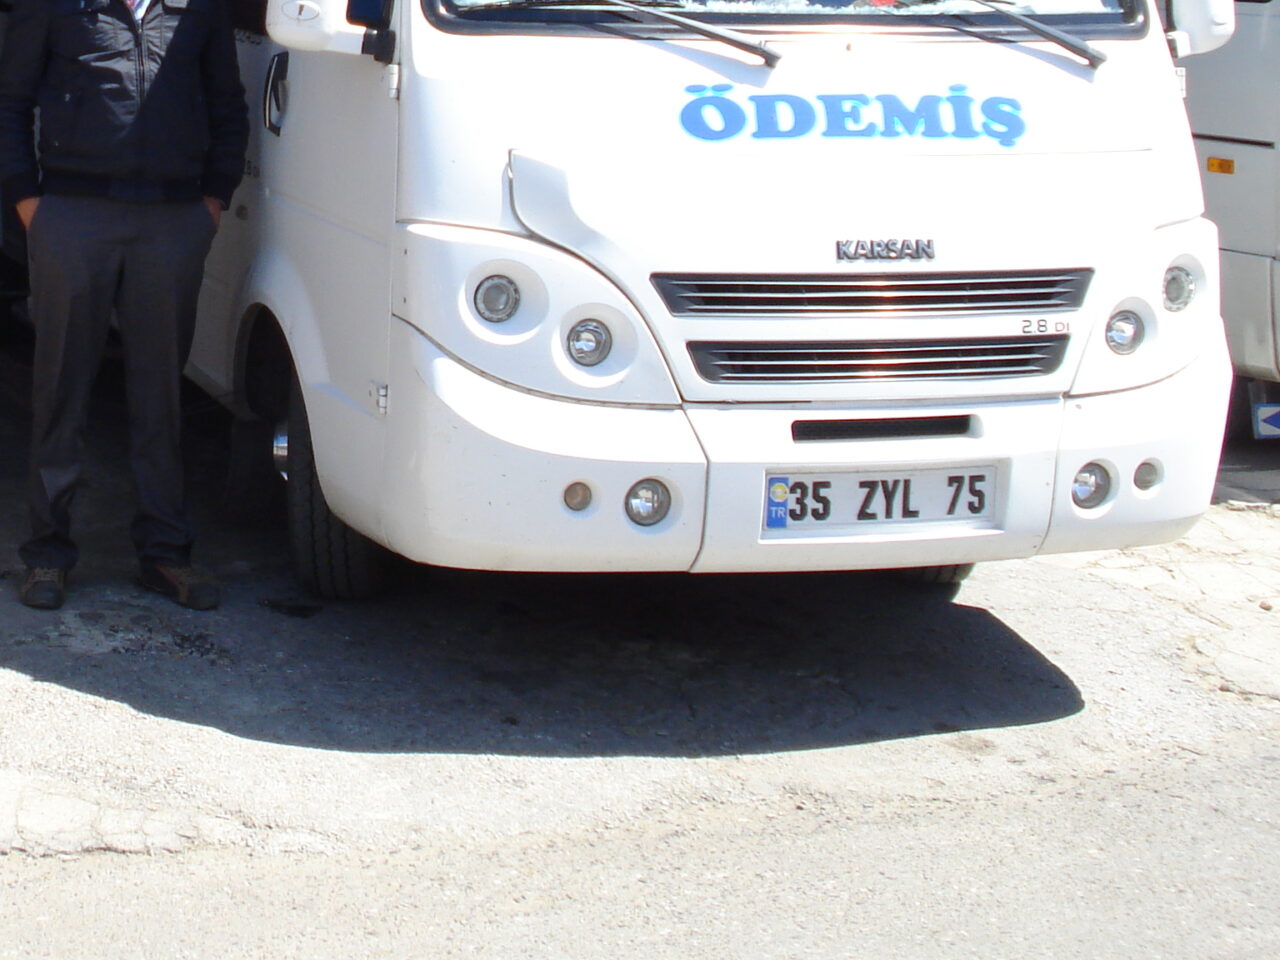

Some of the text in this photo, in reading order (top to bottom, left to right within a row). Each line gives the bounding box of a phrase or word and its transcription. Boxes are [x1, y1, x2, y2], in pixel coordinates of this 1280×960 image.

[679, 83, 1026, 147] ÖDEMİŞ
[836, 239, 936, 262] KARSAN
[1021, 319, 1049, 334] 2.8
[788, 473, 986, 522] 35 ZYL 75
[770, 506, 786, 519] TR
